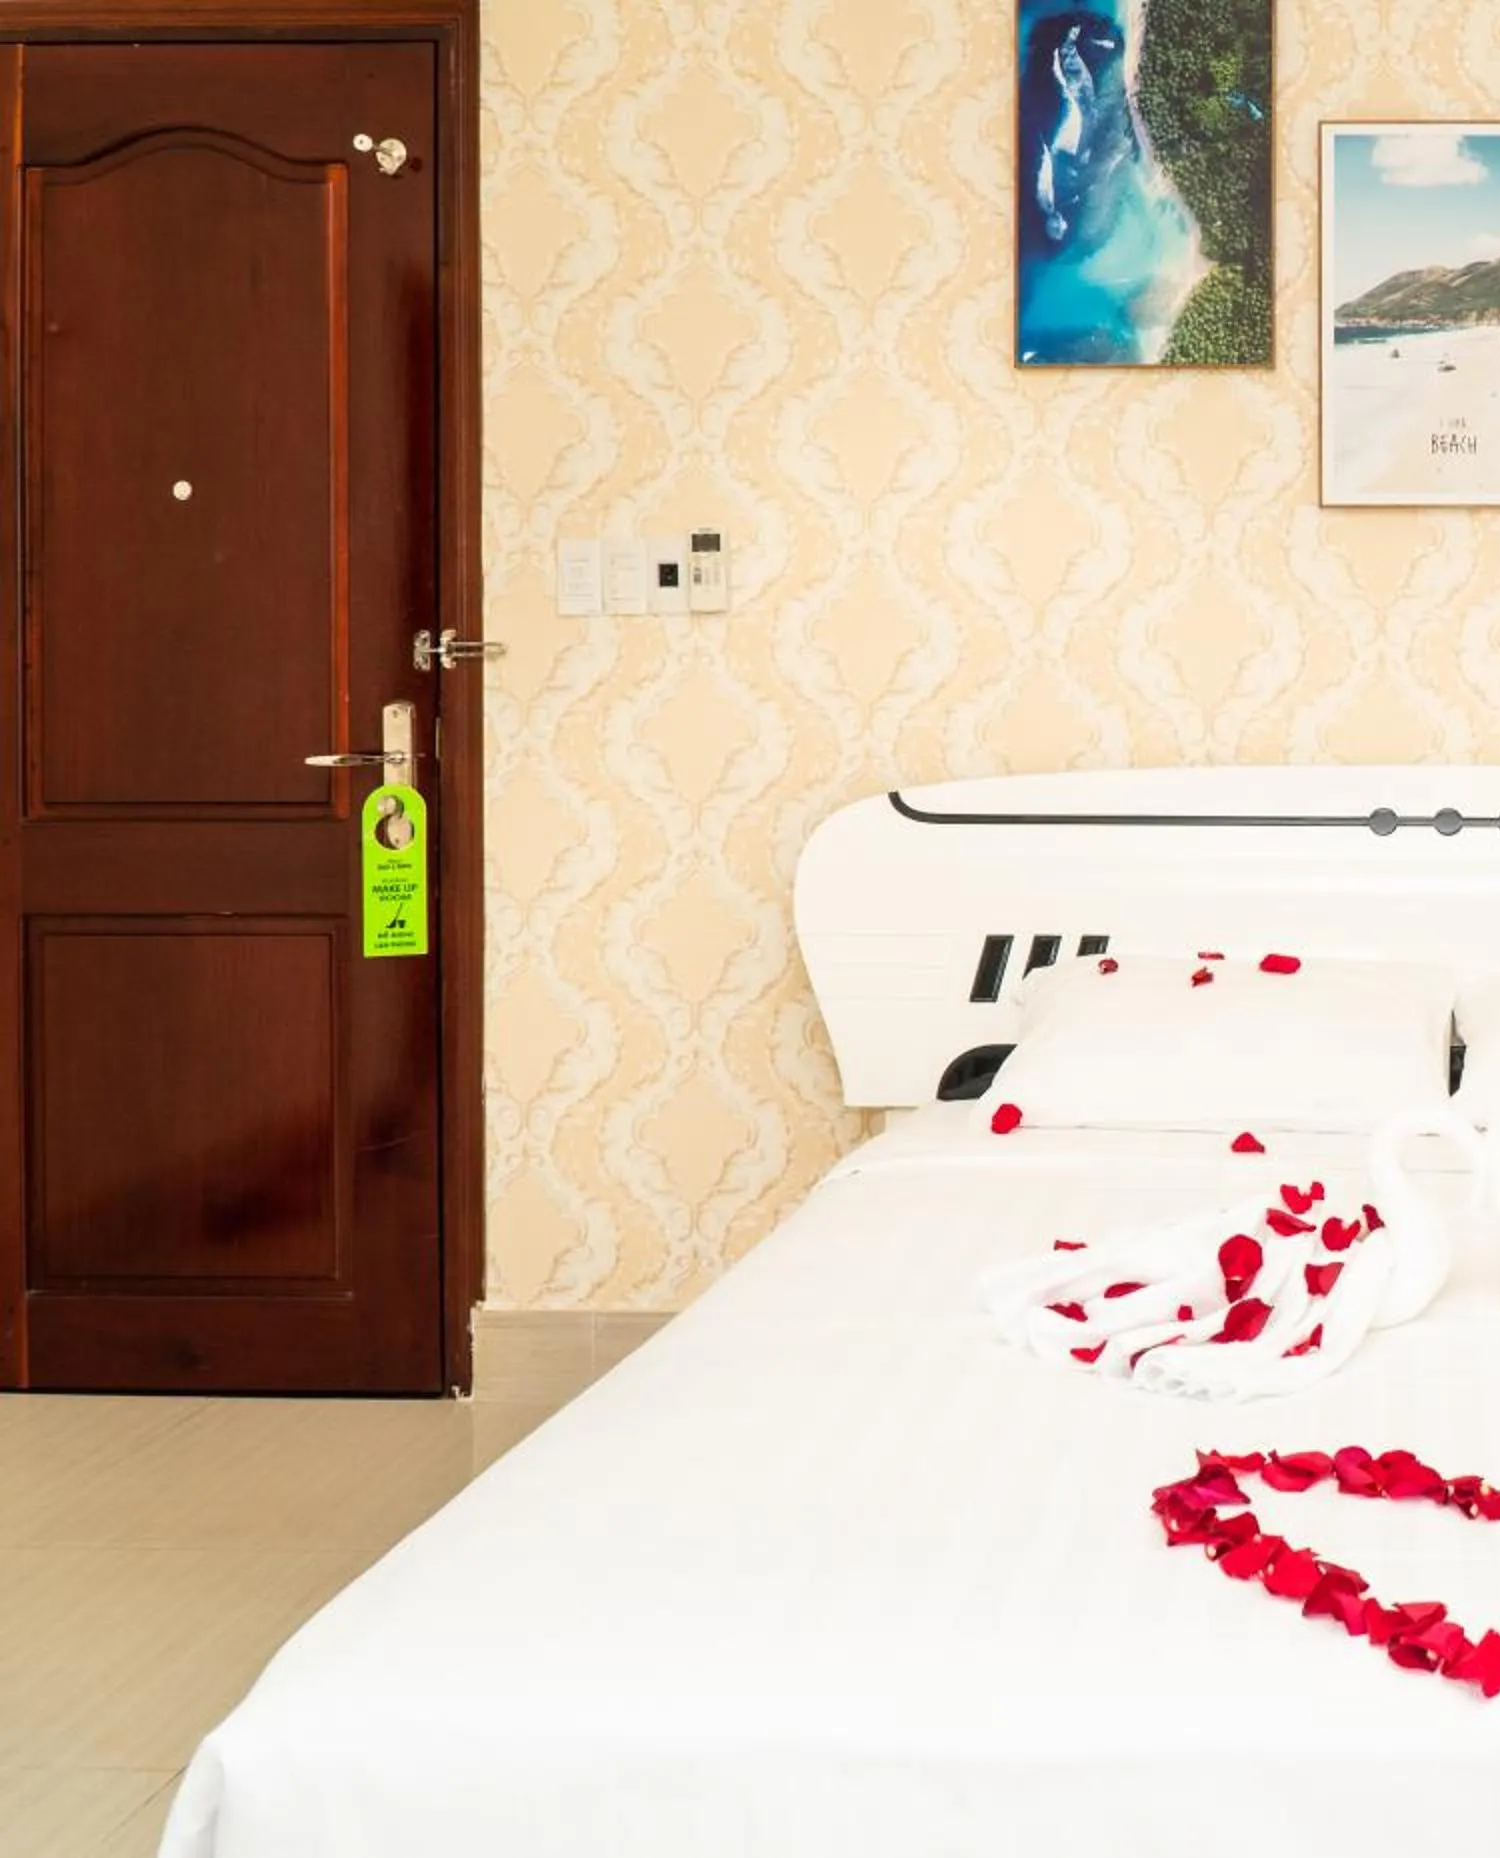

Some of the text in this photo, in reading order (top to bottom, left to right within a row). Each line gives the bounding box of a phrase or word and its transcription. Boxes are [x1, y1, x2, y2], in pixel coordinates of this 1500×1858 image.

[1431, 433, 1478, 455] BEACH
[372, 883, 418, 893] MAKE UP
